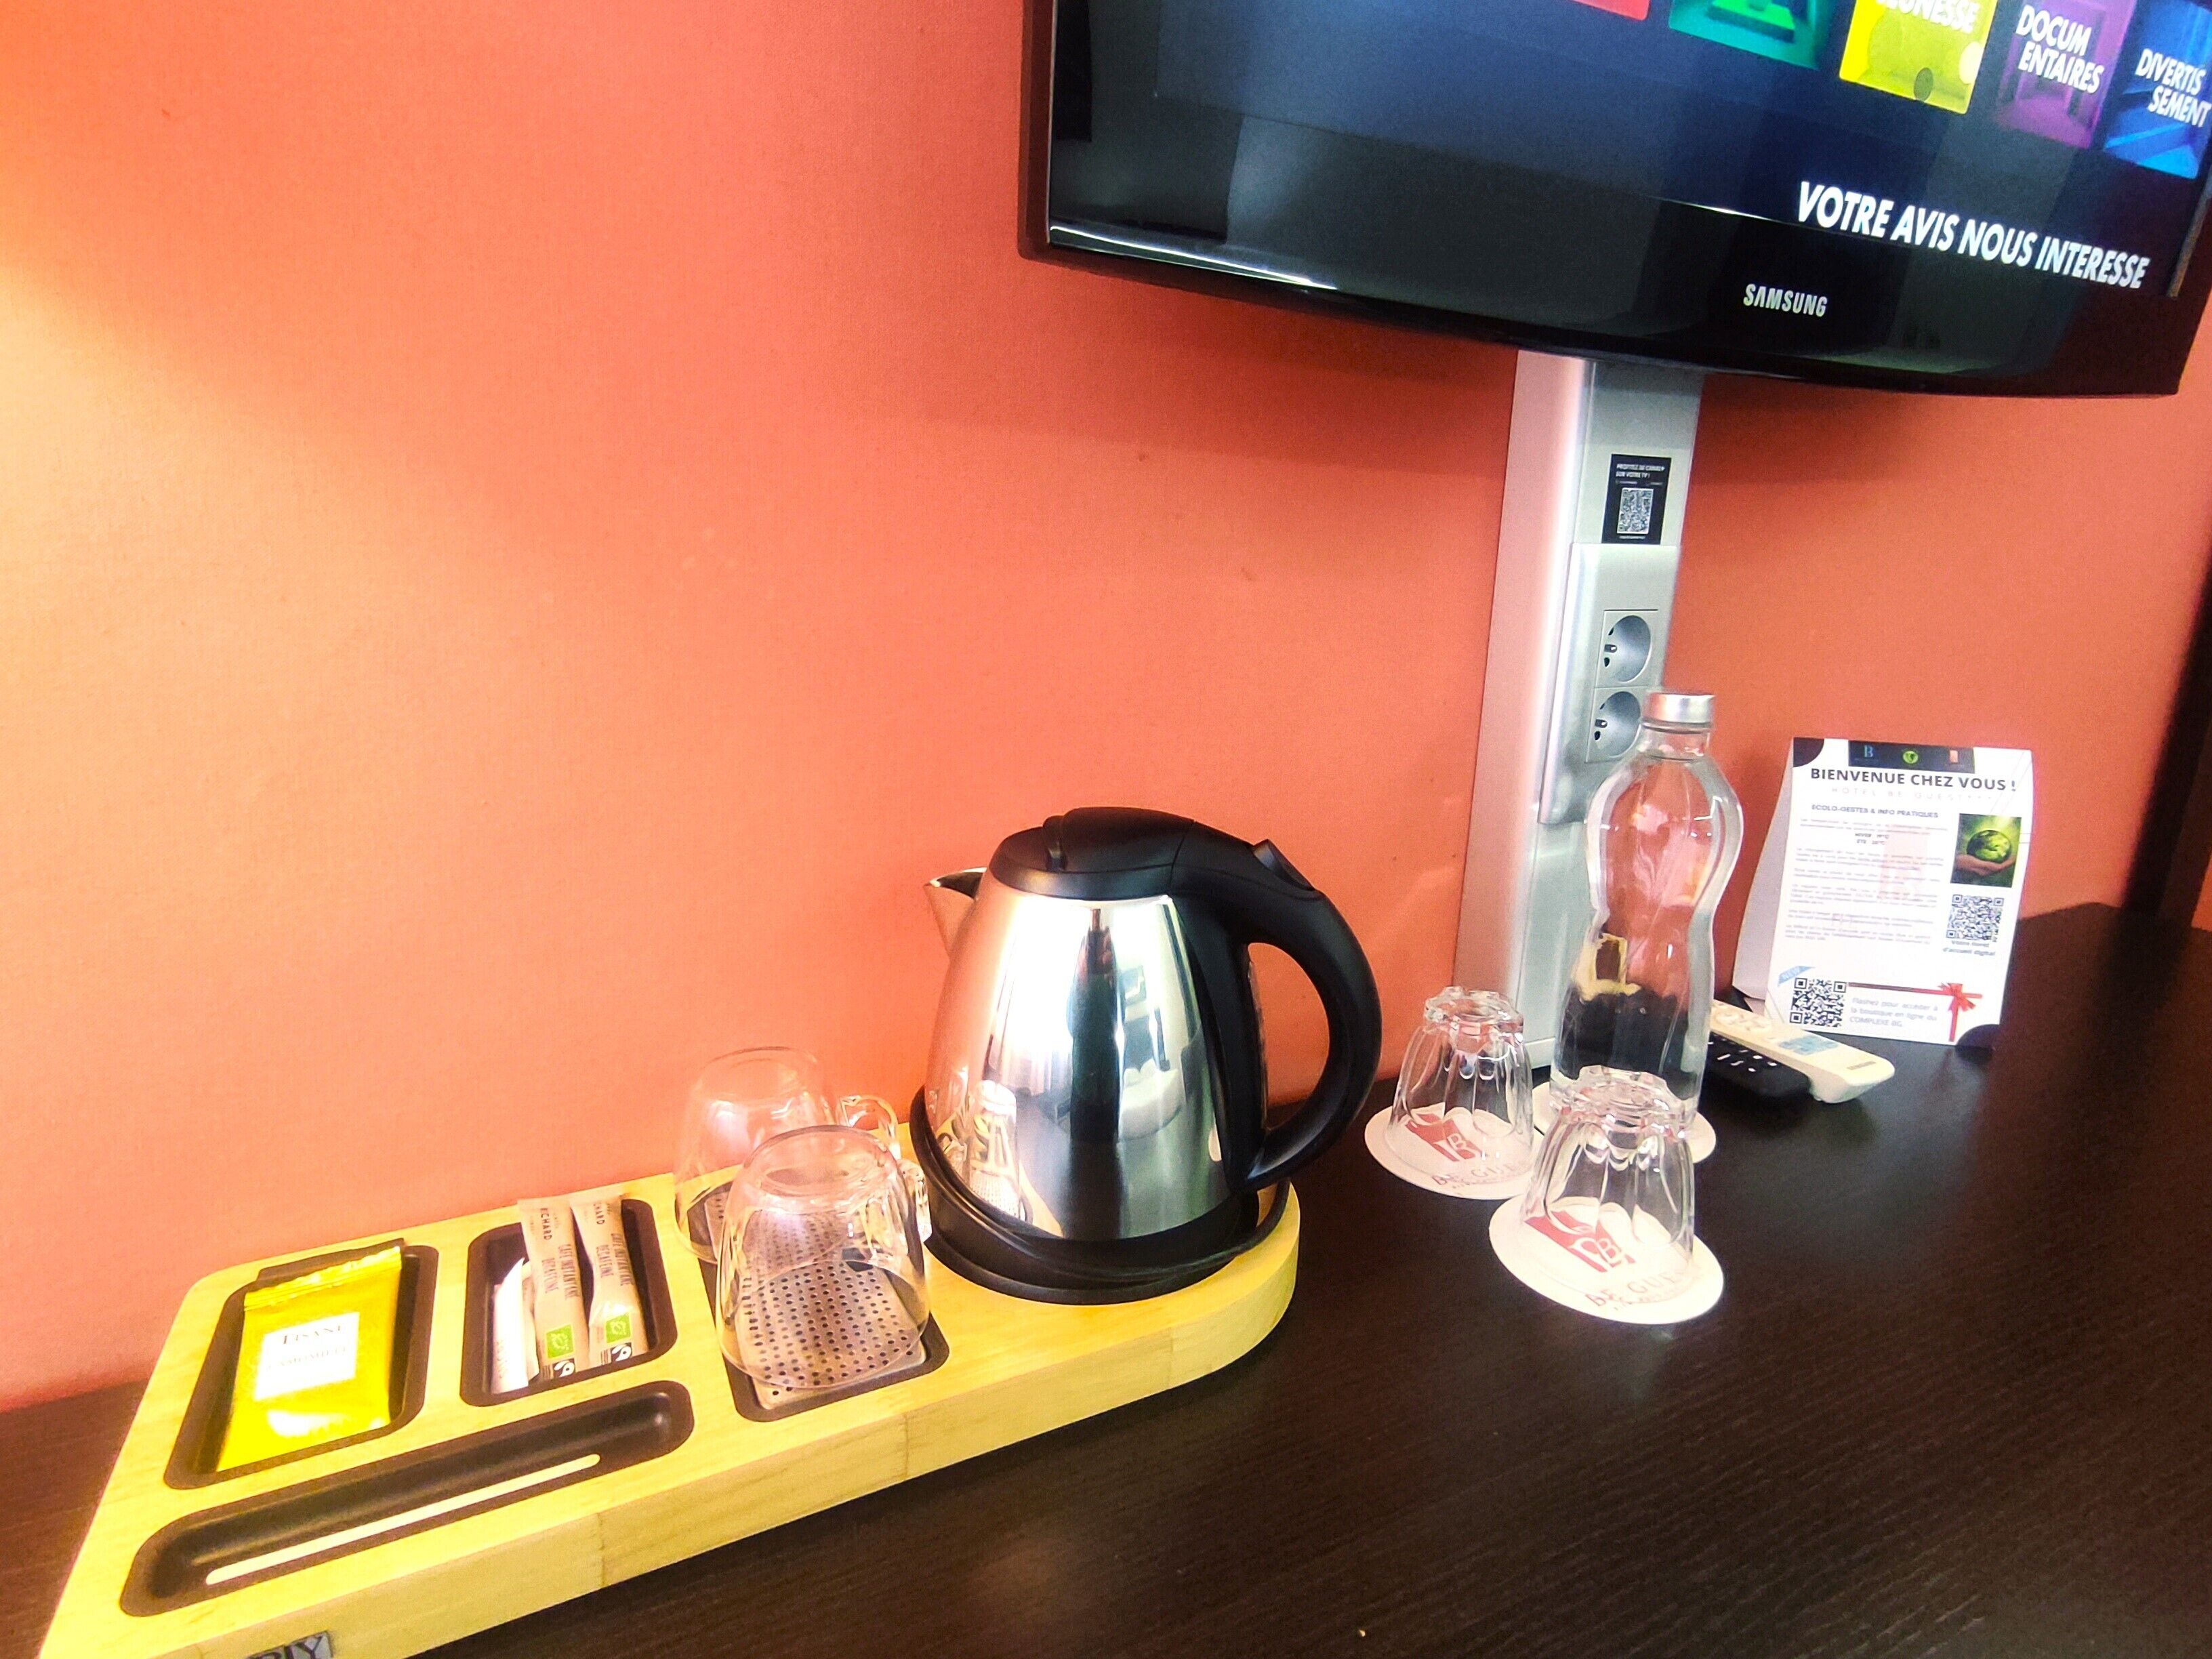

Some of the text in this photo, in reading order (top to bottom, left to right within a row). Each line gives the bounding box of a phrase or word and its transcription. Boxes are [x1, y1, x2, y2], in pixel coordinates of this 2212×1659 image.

[2015, 5, 2092, 56] DOCUM
[2018, 42, 2104, 94] ENTAIRES
[2135, 49, 2207, 95] DIVERTIS
[2148, 85, 2212, 127] SEMENT
[1797, 180, 2151, 289] VOTRE AVIS NOUS INTERESSE
[1743, 283, 1828, 317] SAMSUNG
[1810, 768, 2017, 792] BIENVENUE CHEZ VOUS !
